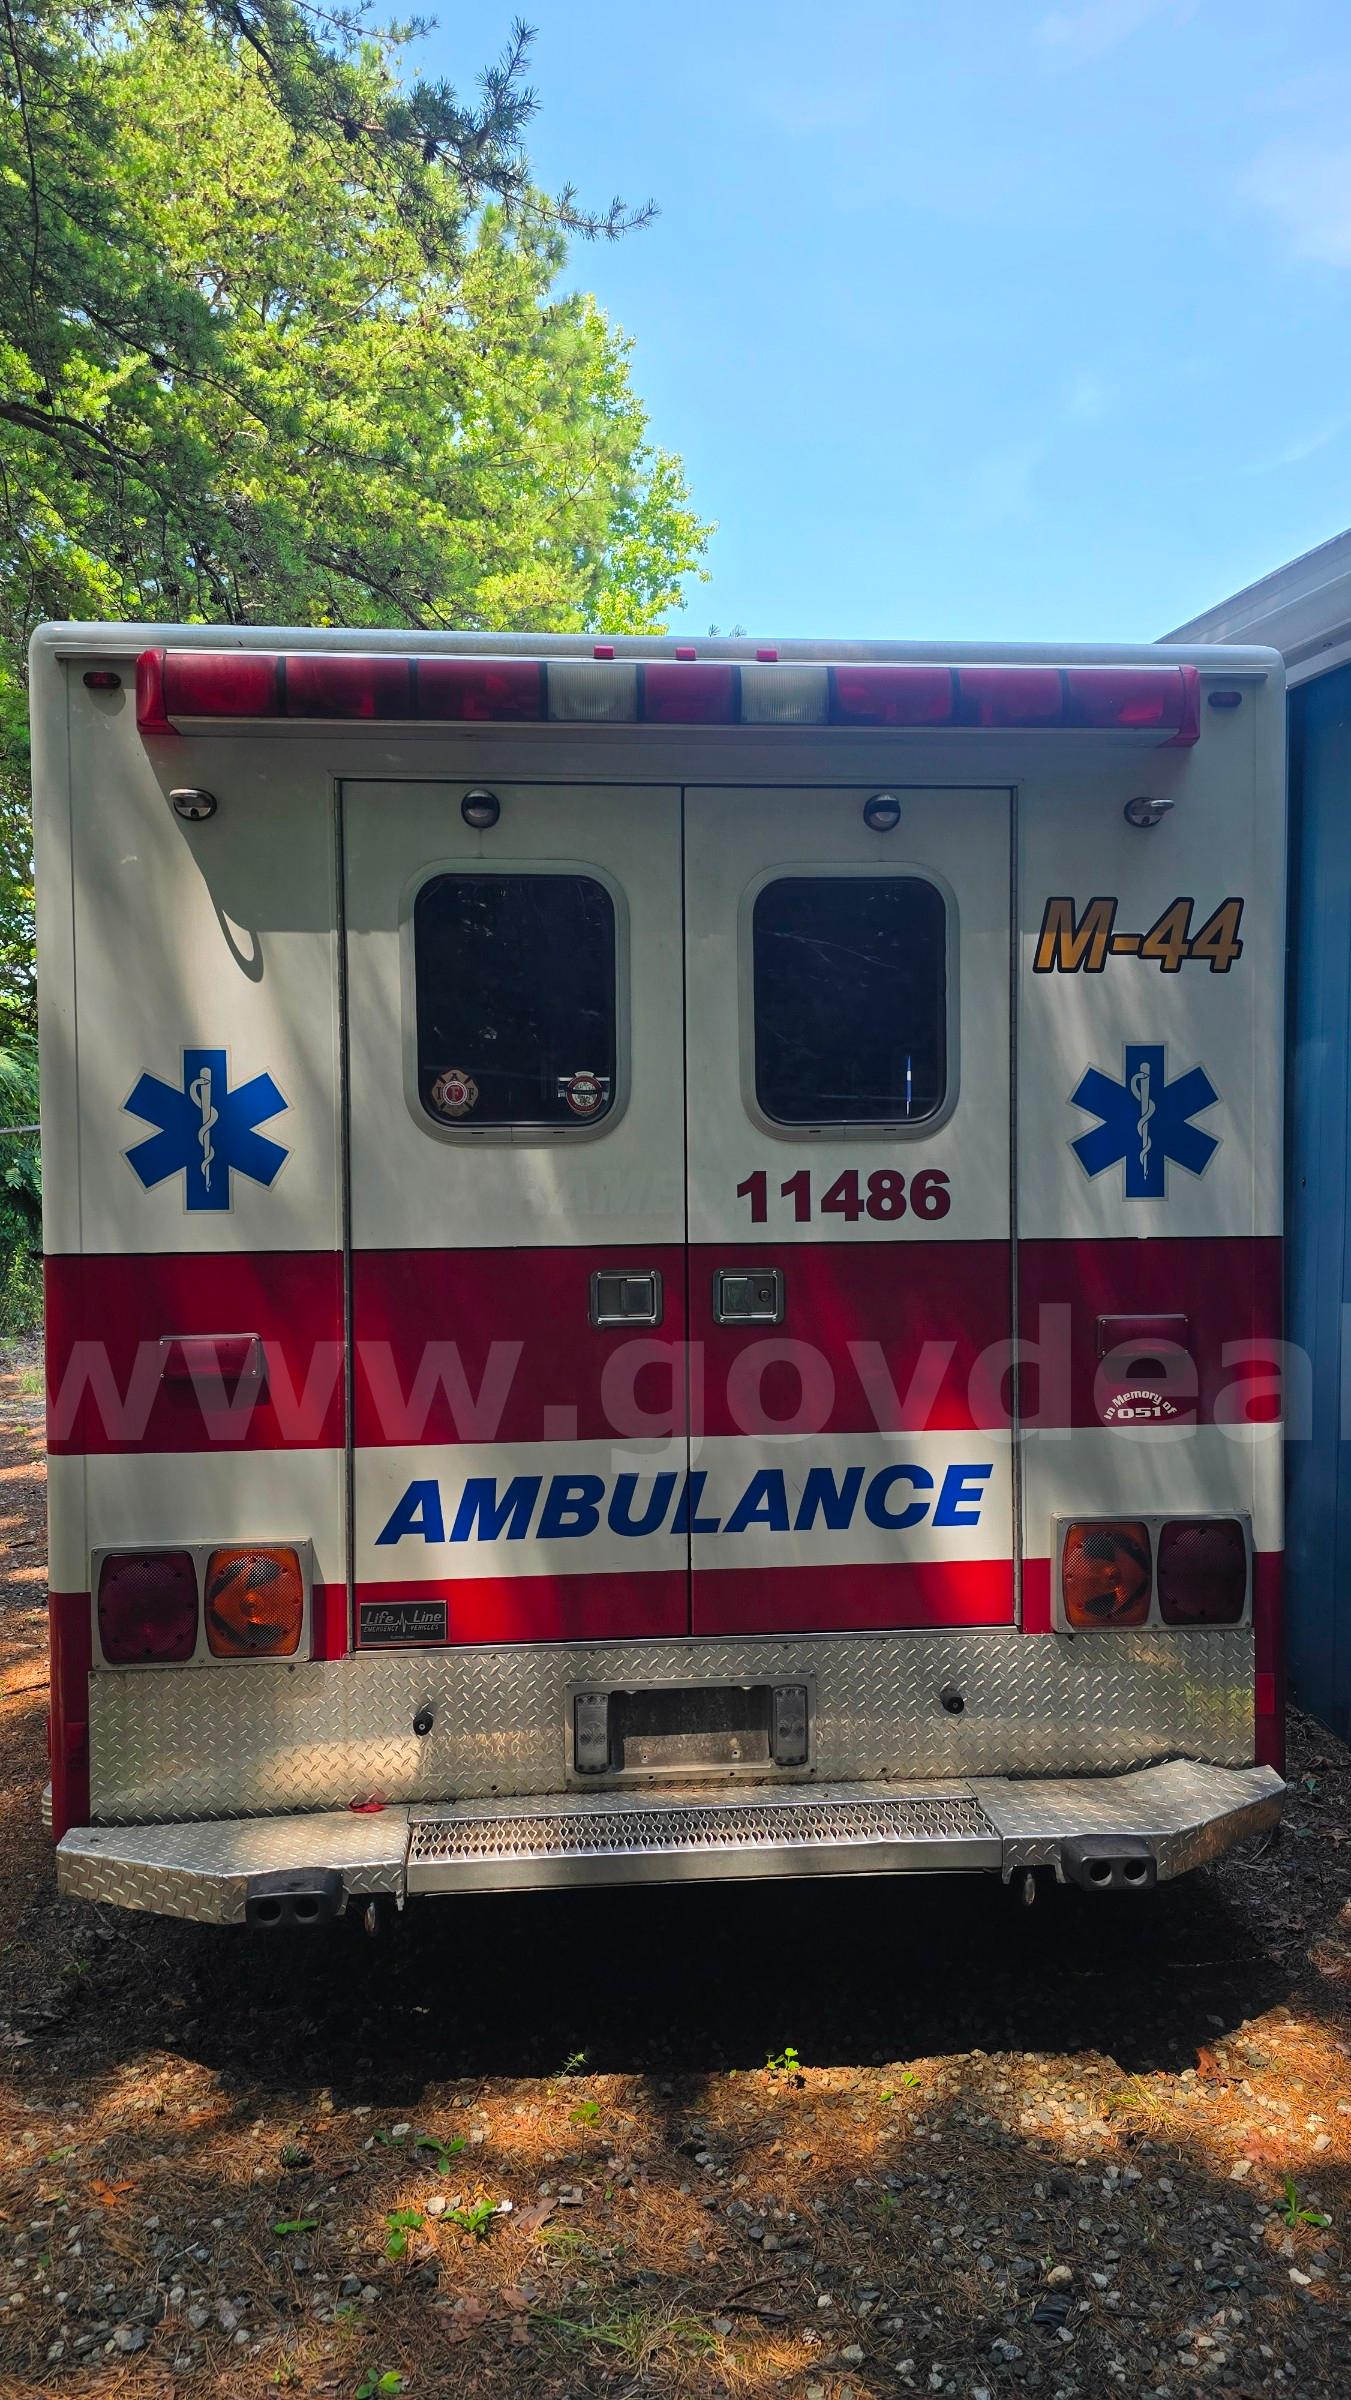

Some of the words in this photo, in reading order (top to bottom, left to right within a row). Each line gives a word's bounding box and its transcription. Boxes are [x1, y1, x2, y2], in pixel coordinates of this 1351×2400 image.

[1032, 896, 1244, 974] M-44
[736, 1168, 952, 1224] 11486
[1112, 1390, 1162, 1407] Memory
[1162, 1401, 1178, 1414] of
[1117, 1407, 1161, 1419] 051
[374, 1463, 994, 1546] AMBULANCE
[366, 1610, 394, 1625] Life
[413, 1609, 442, 1622] Line
